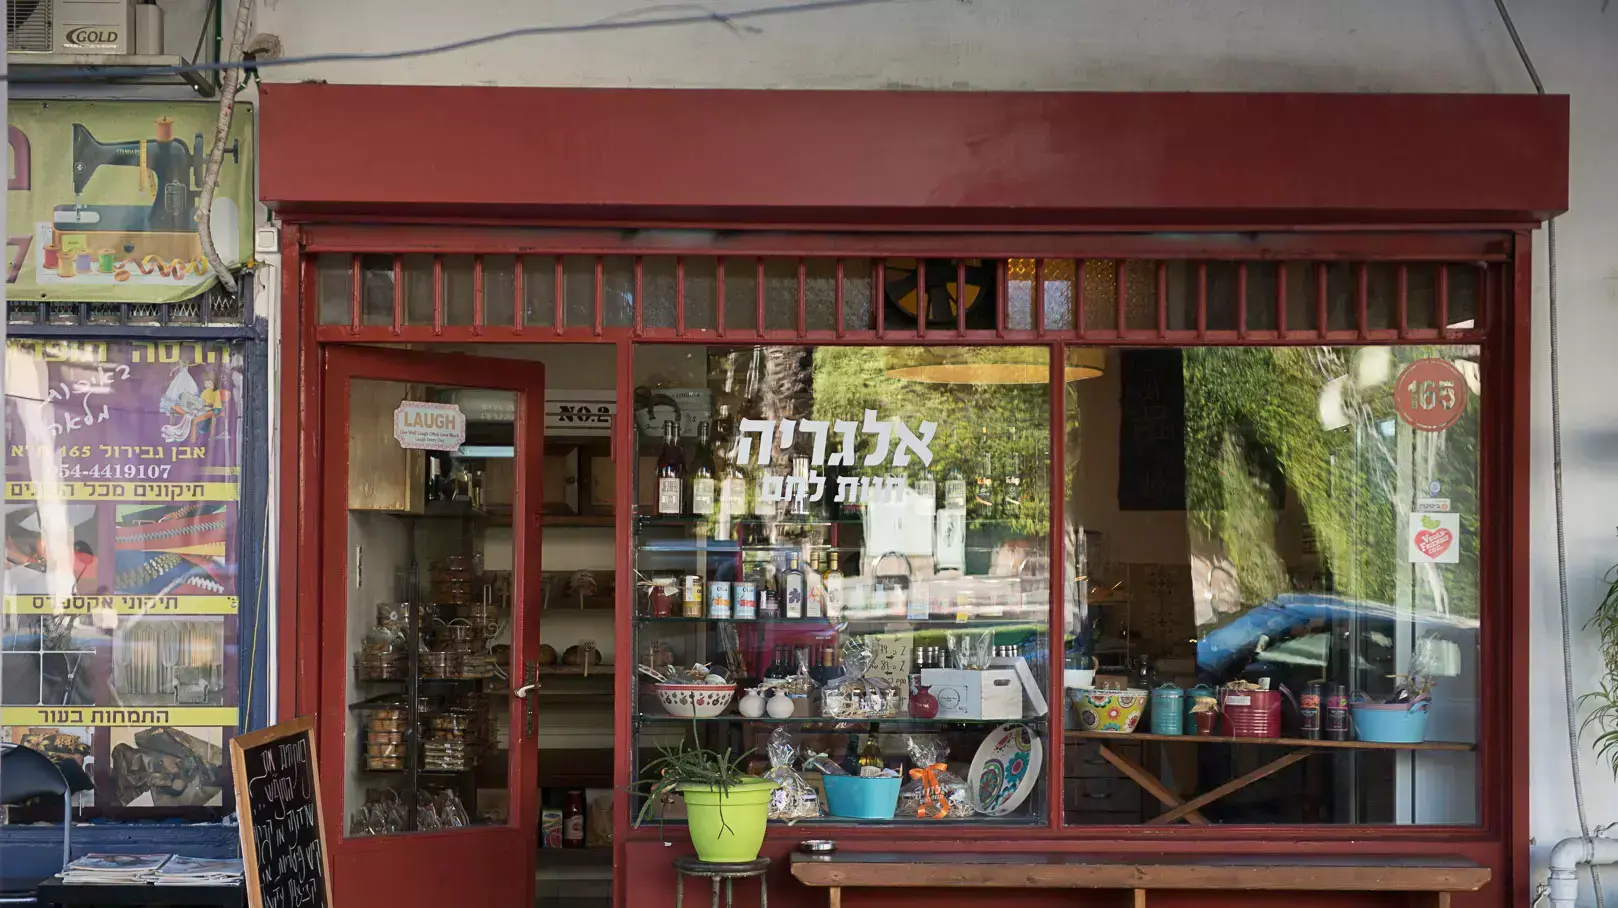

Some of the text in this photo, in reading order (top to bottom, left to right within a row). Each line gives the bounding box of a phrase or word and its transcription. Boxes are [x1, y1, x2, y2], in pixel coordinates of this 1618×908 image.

[76, 30, 118, 43] GOLD
[8, 340, 107, 362] תופר
[1407, 380, 1455, 410] 165
[403, 411, 456, 430] LAUGH
[558, 405, 610, 423] NO.2
[737, 408, 938, 467] אלגריה
[60, 445, 92, 458] 165
[99, 445, 164, 459] גבירול
[172, 446, 205, 462] אבן
[58, 463, 171, 479] 54-4419107
[11, 482, 205, 500] תיקונים מכל הים
[761, 469, 827, 503] לחם
[834, 474, 906, 504] חנות
[32, 596, 178, 614] תיקוני אקספס
[38, 710, 169, 724] התמחות בעור
